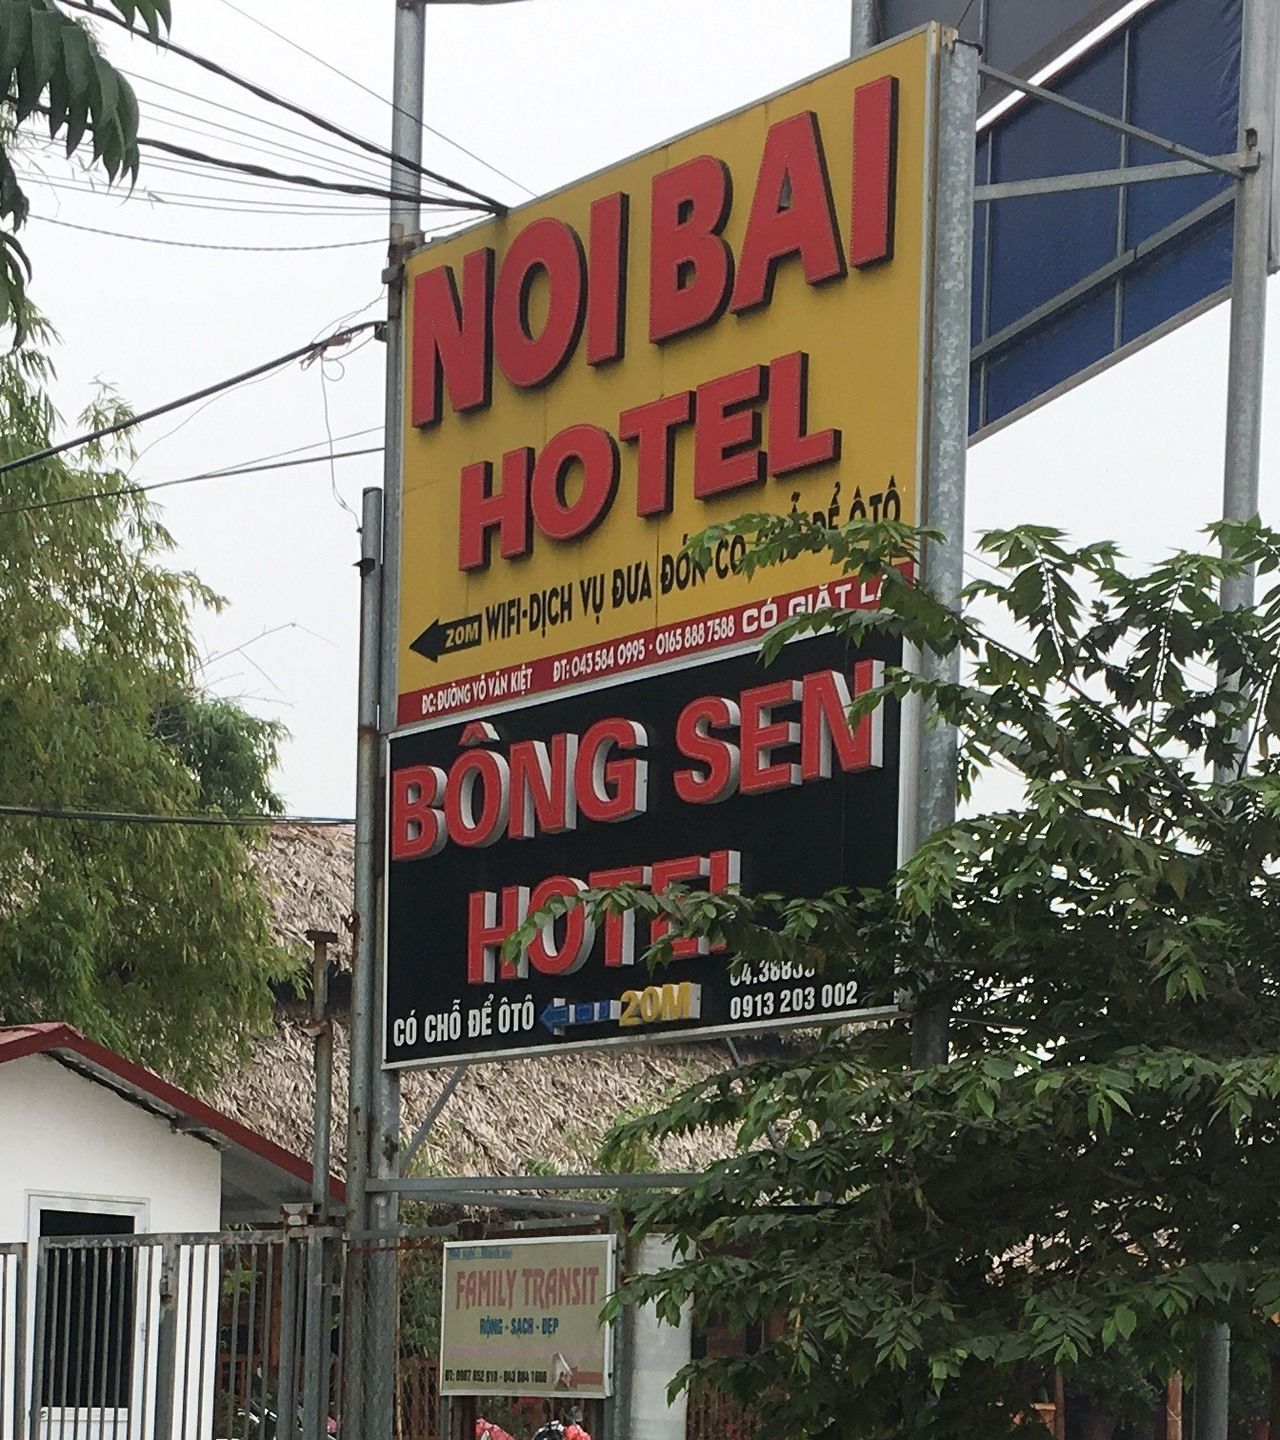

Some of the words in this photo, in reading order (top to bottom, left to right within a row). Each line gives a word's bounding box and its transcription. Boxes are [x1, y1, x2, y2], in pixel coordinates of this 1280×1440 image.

[411, 191, 629, 428] NOI
[649, 74, 899, 344] BAI
[458, 350, 841, 571] HOTEL
[579, 573, 605, 624] VỤ
[511, 663, 533, 696] KIỆT
[553, 660, 570, 682] ĐT:
[571, 652, 593, 677] 043
[594, 646, 615, 671] 584
[617, 638, 646, 665] 0995
[655, 629, 683, 656] 0165
[684, 624, 705, 649] 888
[707, 614, 736, 643] 7588
[741, 597, 779, 634] CÓ
[392, 720, 648, 861] BÔNG
[673, 658, 885, 804] SEN
[393, 1008, 418, 1047] CÓ
[424, 999, 461, 1043] CHỖ
[468, 993, 494, 1038] ĐỂ
[498, 993, 536, 1033] ÔTÔ
[620, 982, 701, 1026] 20M
[730, 991, 775, 1020] 0913
[779, 986, 816, 1013] 203
[821, 980, 858, 1009] 002
[455, 1268, 518, 1311] FAMILY
[521, 1266, 600, 1310] TRANSIT
